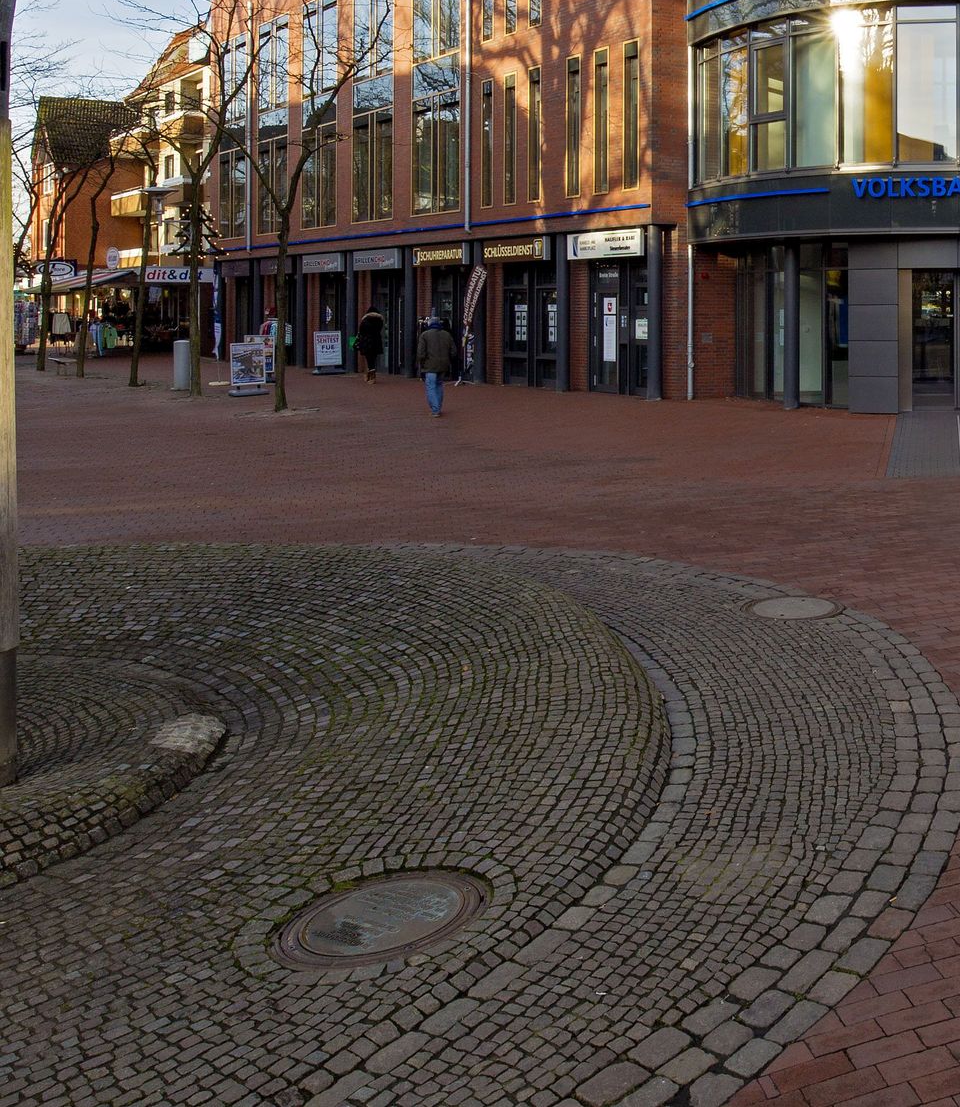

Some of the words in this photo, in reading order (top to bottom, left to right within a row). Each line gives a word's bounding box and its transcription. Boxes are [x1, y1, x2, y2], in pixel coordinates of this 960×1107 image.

[420, 248, 463, 261] SCHUHREPARATUR
[484, 244, 533, 258] SCHLÜSSELDIENST
[147, 269, 203, 280] dit&dt
